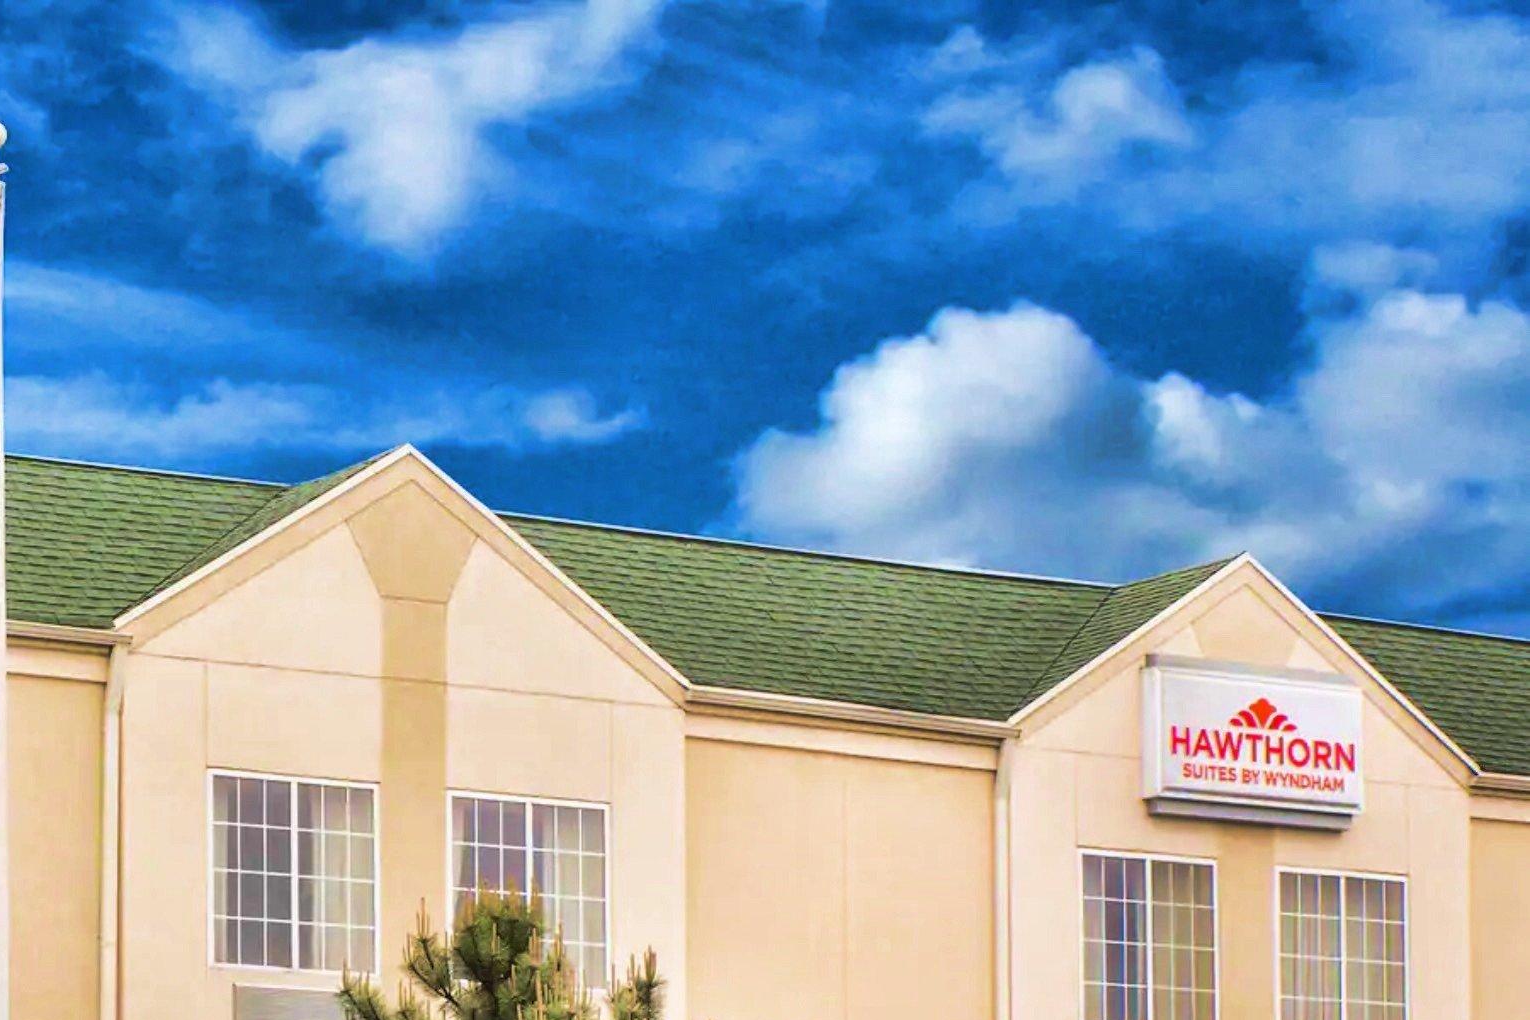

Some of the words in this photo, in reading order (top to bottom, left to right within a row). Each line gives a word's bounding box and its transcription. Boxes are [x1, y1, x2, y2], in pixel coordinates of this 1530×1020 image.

[1171, 726, 1355, 772] HAWTHORN
[1182, 763, 1237, 781] SUITES
[1242, 768, 1260, 784] BY
[1264, 770, 1345, 792] WYNDHAM
